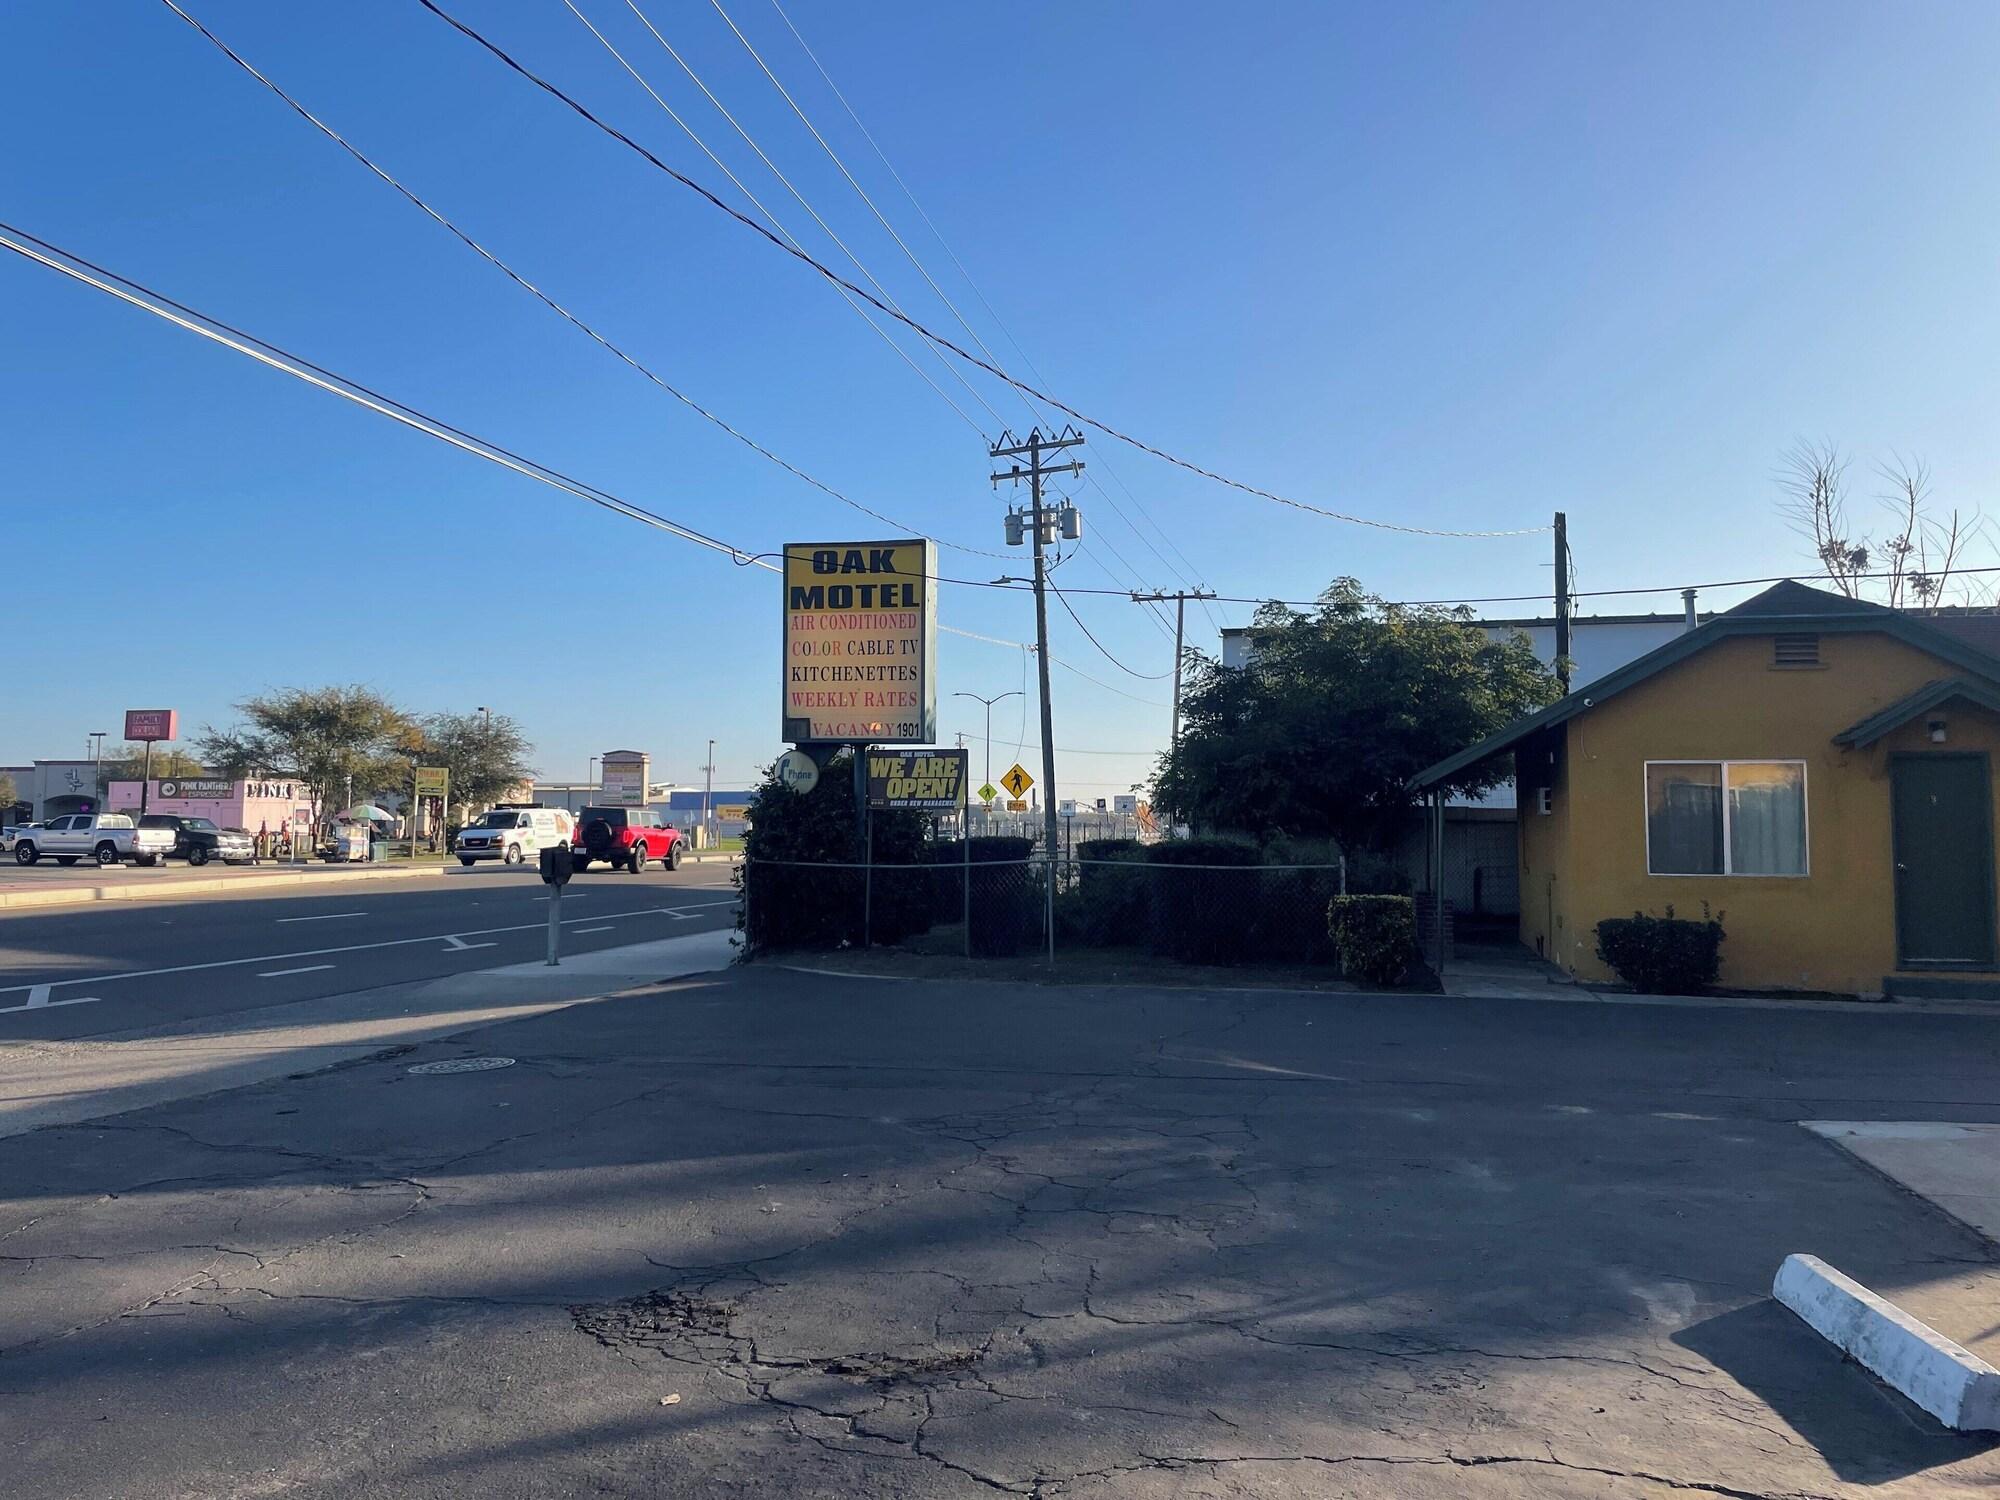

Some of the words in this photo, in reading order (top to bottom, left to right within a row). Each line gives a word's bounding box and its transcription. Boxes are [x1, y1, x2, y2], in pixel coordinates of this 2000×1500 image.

[813, 549, 896, 574] OAK
[790, 583, 920, 610] MOTEL
[791, 616, 815, 631] AIR
[820, 613, 917, 630] CONDITIONED
[792, 640, 841, 656] COLOR
[847, 640, 895, 655] CABLE
[900, 639, 919, 655] TV
[791, 665, 917, 682] KITCHENETTES
[791, 692, 858, 708] WEEKLY
[863, 691, 917, 707] RATES
[813, 723, 895, 737] VACANCY
[896, 722, 919, 737] 1901
[788, 768, 813, 780] Phone
[870, 757, 906, 778] WE
[911, 757, 960, 778] ARE
[180, 781, 198, 791] PINK
[247, 783, 292, 799] PINK
[886, 778, 956, 799] OPEN!
